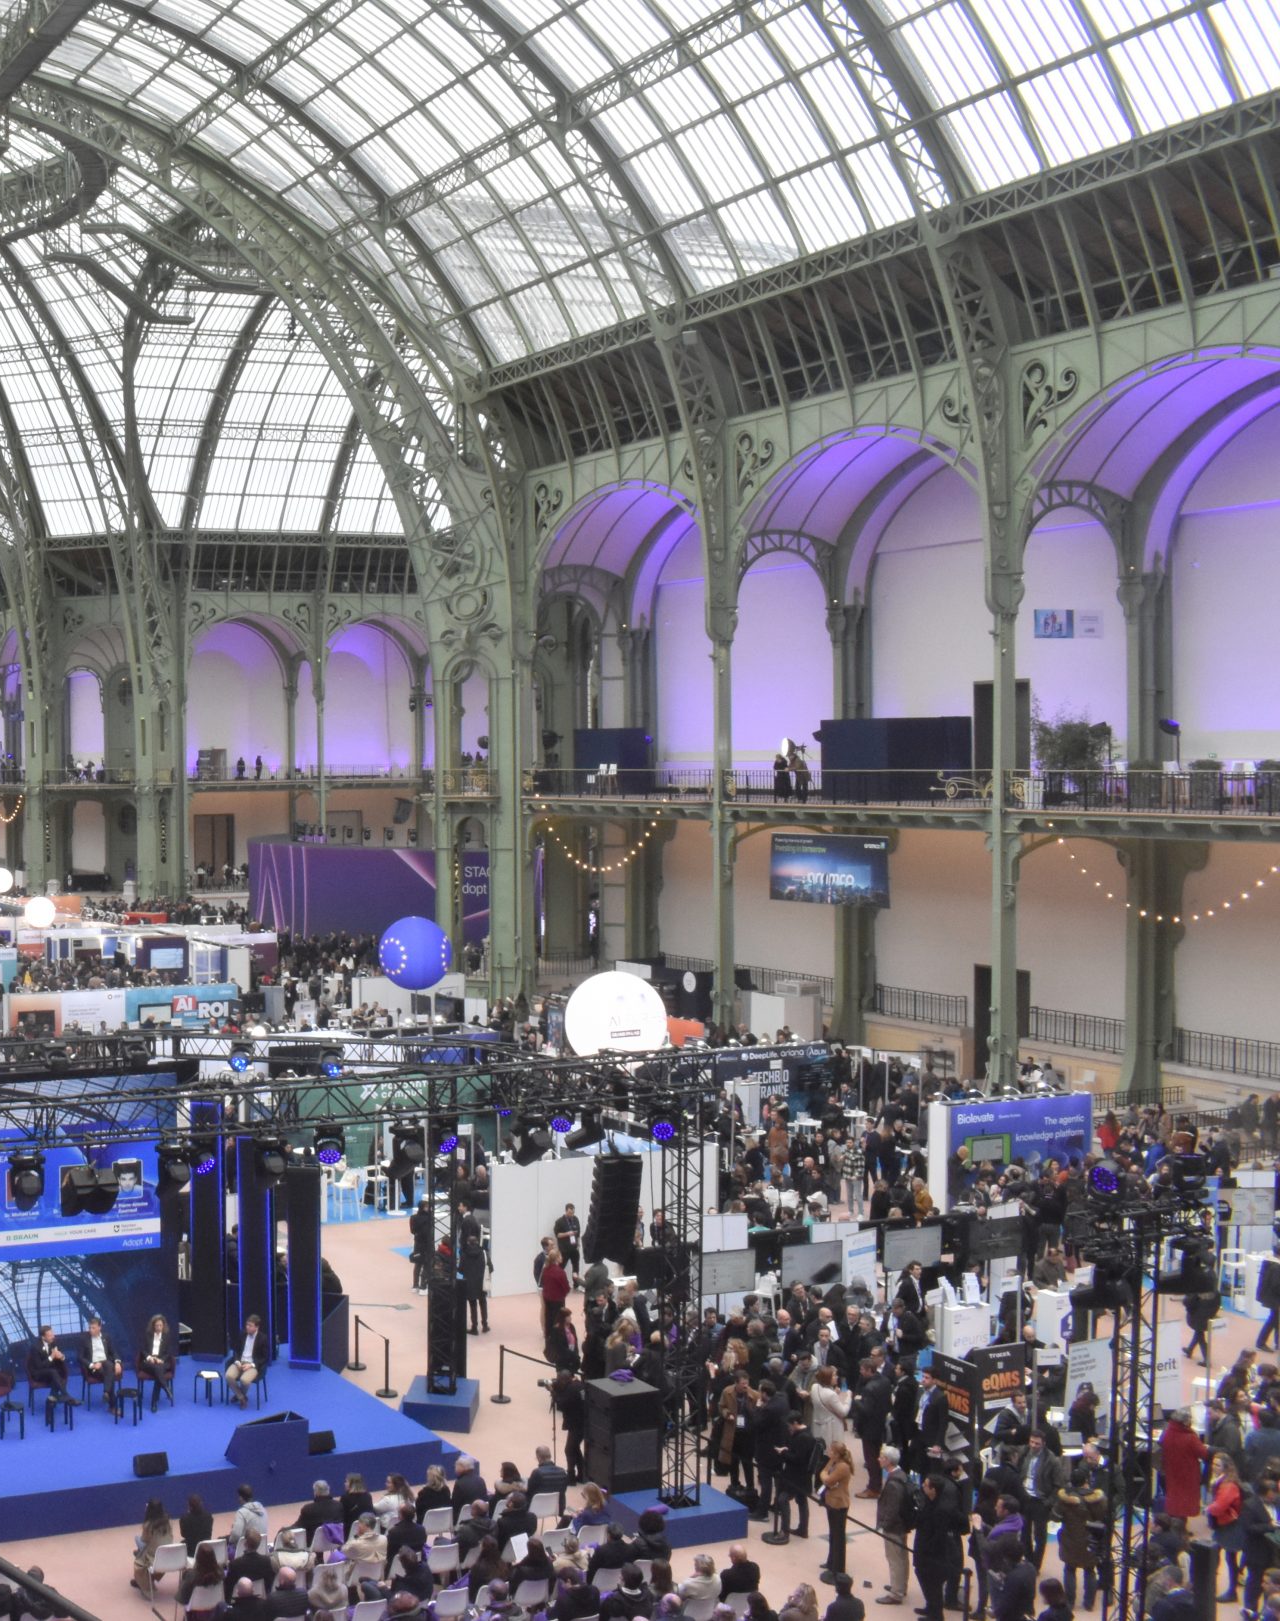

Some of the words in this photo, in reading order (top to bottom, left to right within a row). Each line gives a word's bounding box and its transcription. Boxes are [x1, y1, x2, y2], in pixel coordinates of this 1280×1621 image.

[462, 883, 487, 896] dopt
[176, 997, 193, 1012] AI
[198, 1001, 229, 1019] ROI
[752, 1069, 789, 1084] TECHBO
[760, 1084, 789, 1099] RANE
[957, 1112, 995, 1125] Biolevate
[1044, 1116, 1058, 1126] The
[1059, 1114, 1085, 1125] agentic
[1015, 1131, 1053, 1142] knowledge
[1055, 1128, 1085, 1140] platform
[982, 1370, 1021, 1391] eQMS
